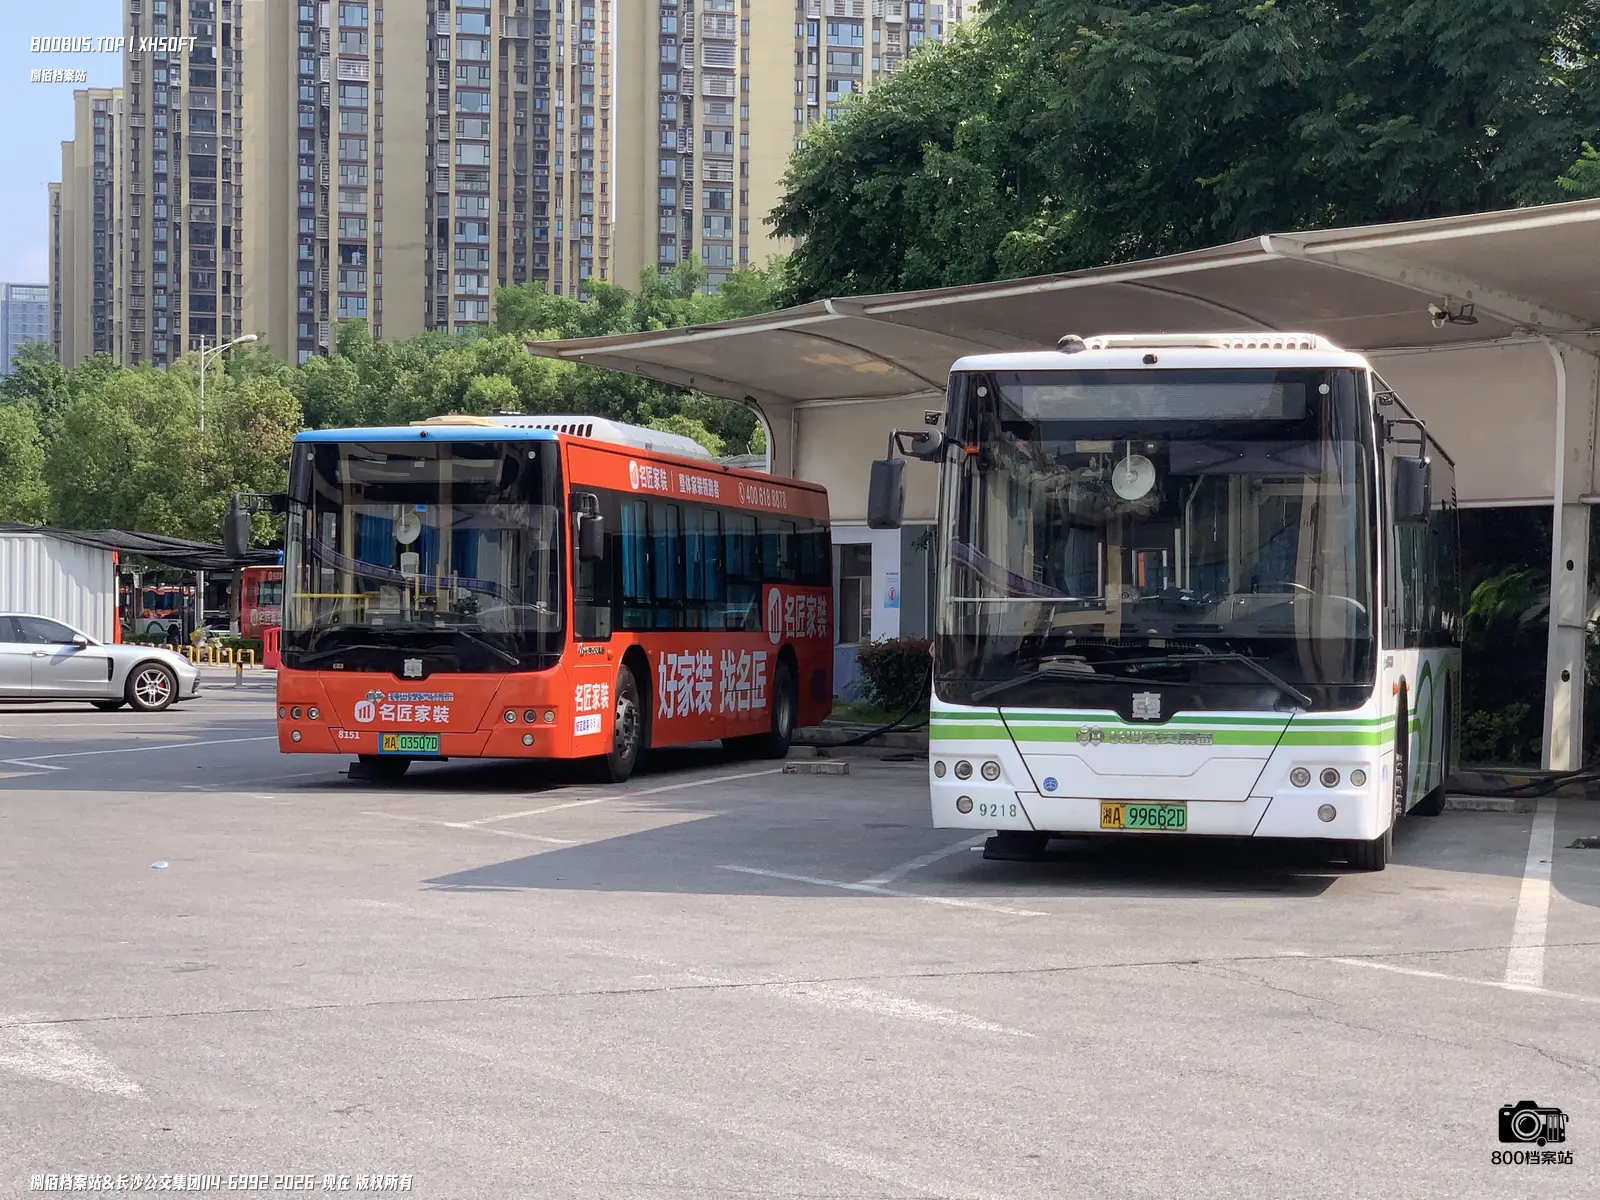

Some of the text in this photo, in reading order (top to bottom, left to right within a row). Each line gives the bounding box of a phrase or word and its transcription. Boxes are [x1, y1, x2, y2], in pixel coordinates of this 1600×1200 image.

[746, 485, 758, 505] 400
[760, 487, 771, 507] 618
[658, 649, 767, 719] 好家装 找名匠
[338, 731, 360, 740] 8151
[980, 803, 1017, 818] 9218
